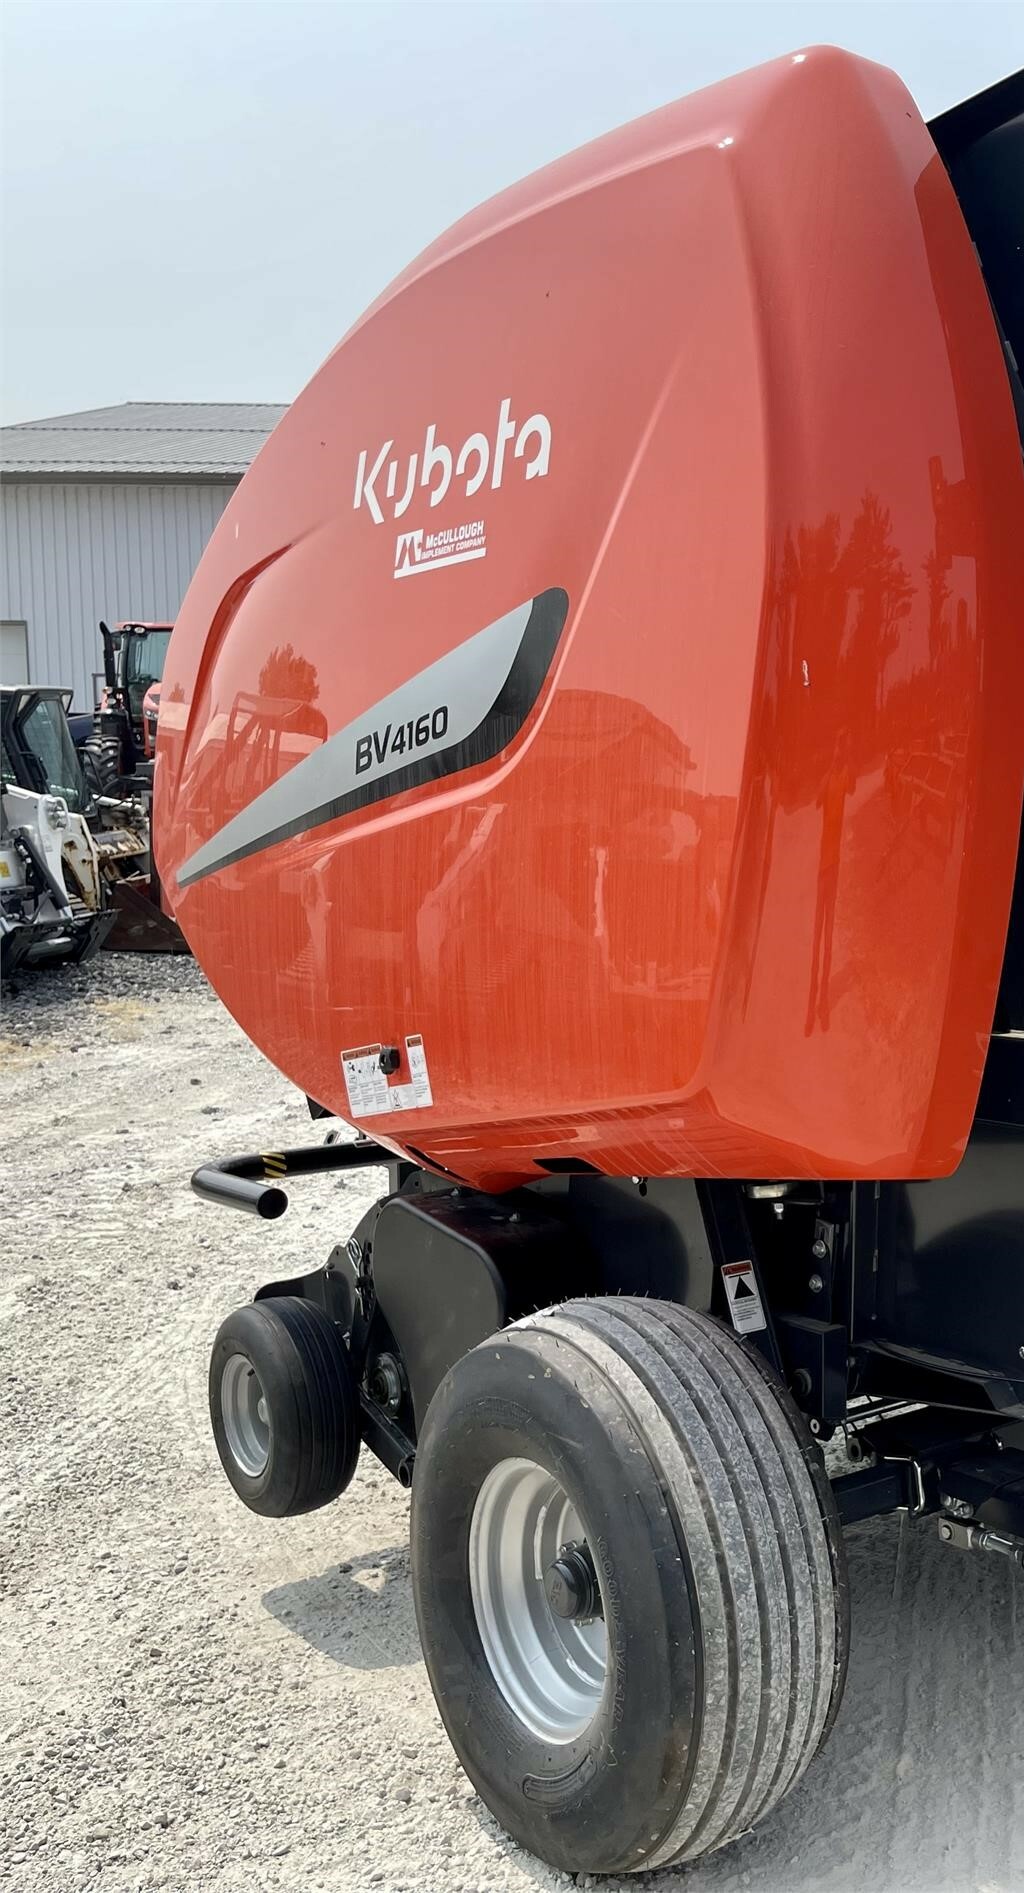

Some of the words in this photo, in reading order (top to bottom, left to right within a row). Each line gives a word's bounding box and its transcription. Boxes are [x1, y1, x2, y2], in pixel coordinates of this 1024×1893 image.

[353, 397, 552, 525] Kubota
[455, 535, 486, 552] COMPANY
[355, 705, 449, 775] BV4160
